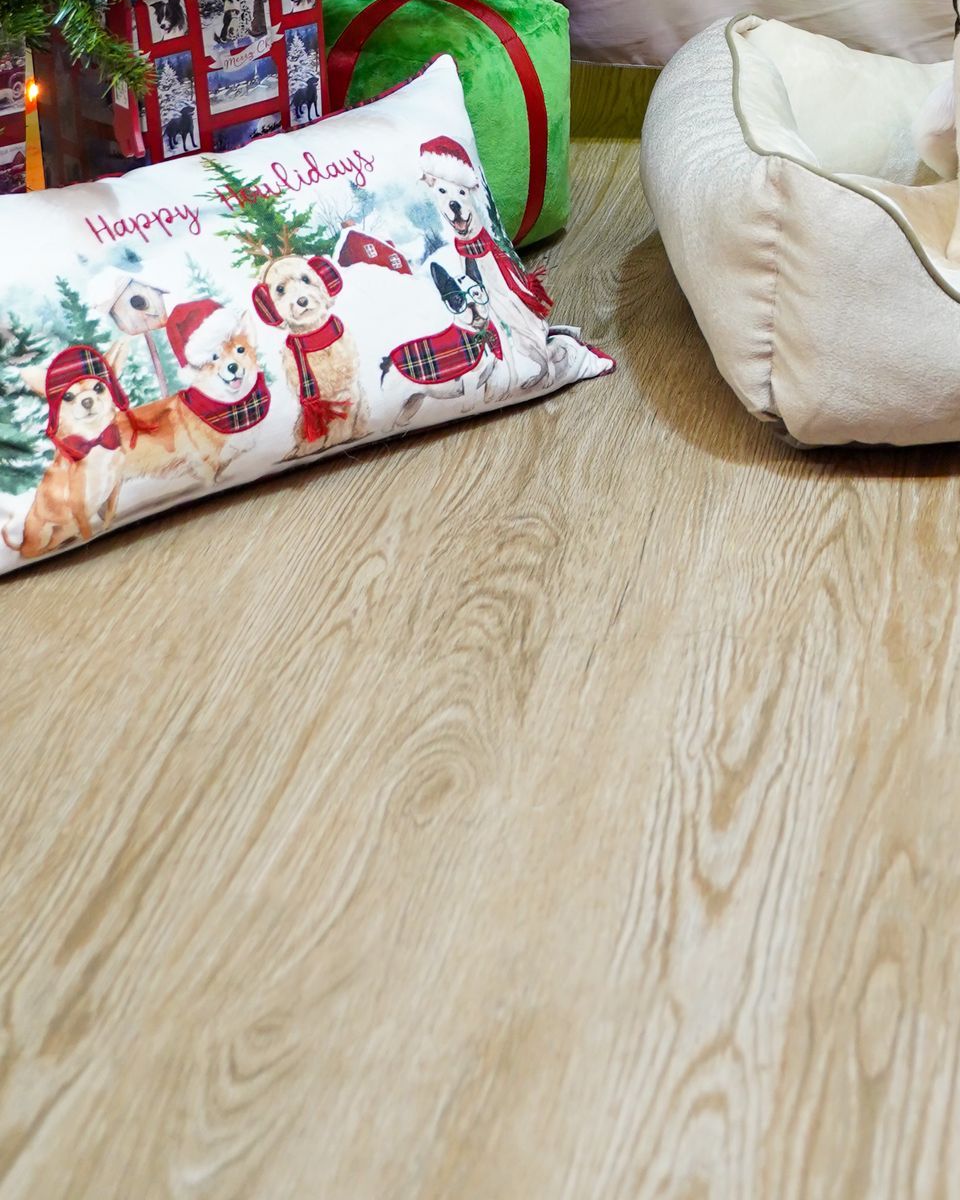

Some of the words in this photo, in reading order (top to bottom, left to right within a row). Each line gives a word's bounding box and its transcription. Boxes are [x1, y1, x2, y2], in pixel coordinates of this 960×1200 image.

[223, 51, 255, 69] Merry
[85, 204, 200, 244] Happy
[214, 150, 375, 211] Howlidays
